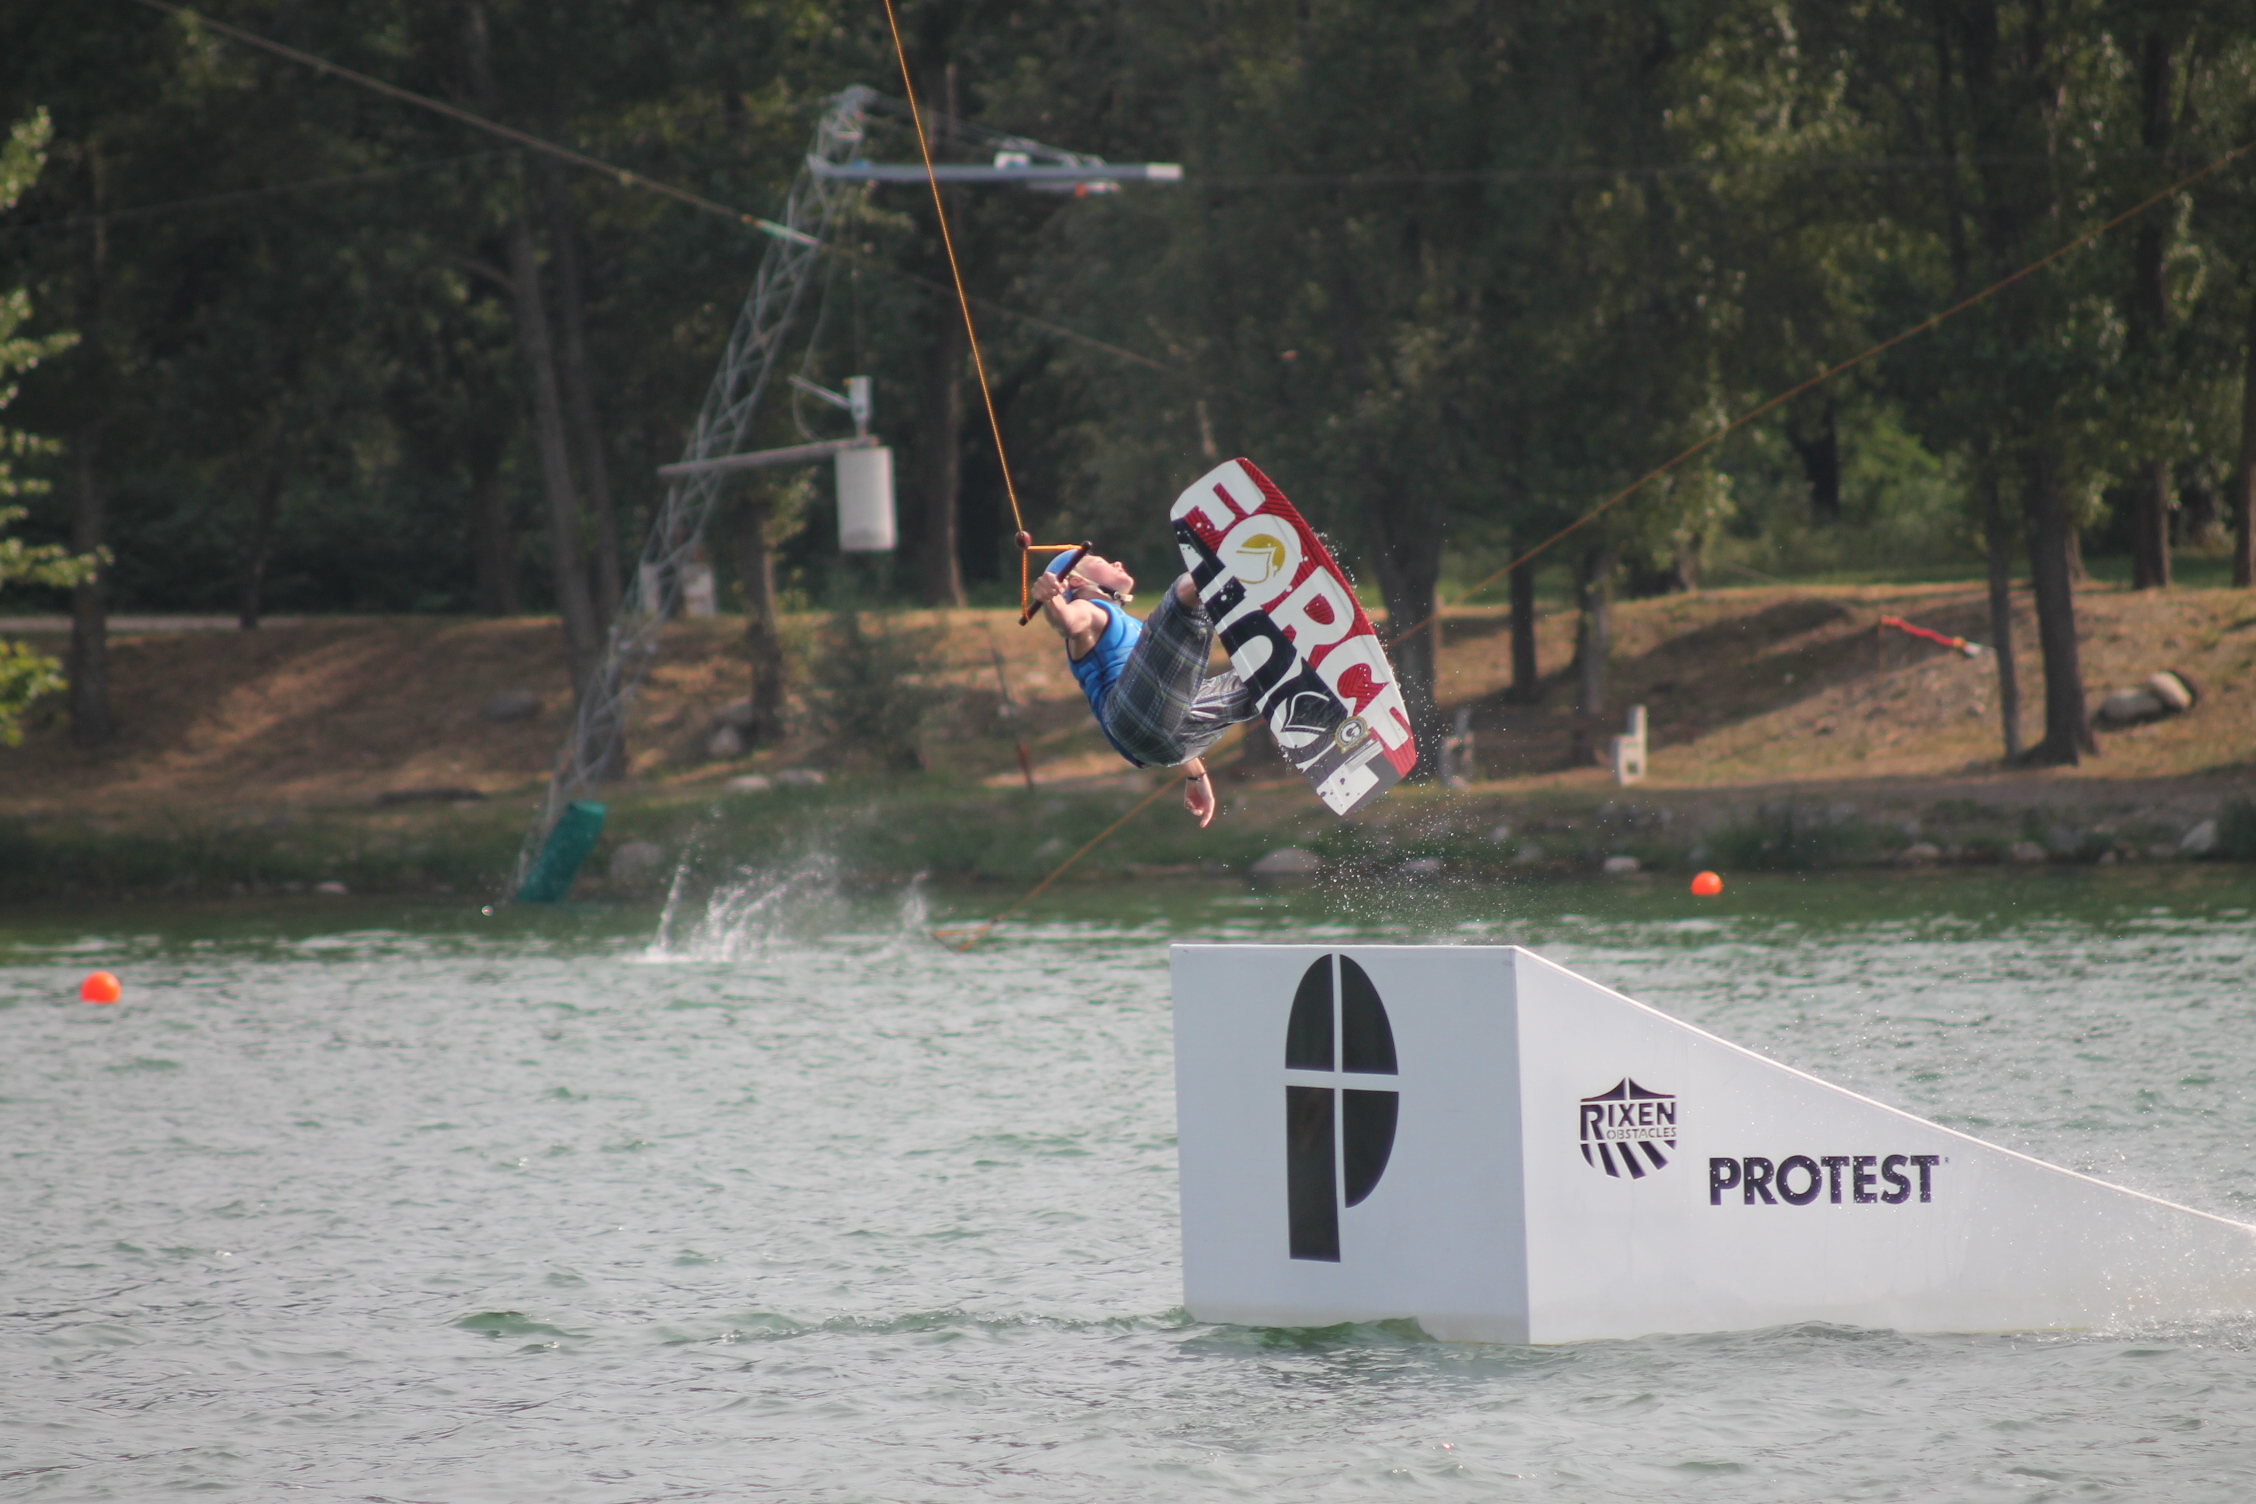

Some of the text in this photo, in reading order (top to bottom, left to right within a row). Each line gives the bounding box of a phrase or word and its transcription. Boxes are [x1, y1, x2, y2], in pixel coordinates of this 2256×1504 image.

[1580, 1103, 1676, 1141] RIXEN
[1606, 1128, 1676, 1140] OBSTACLES
[1708, 1154, 1940, 1206] PROTEST
